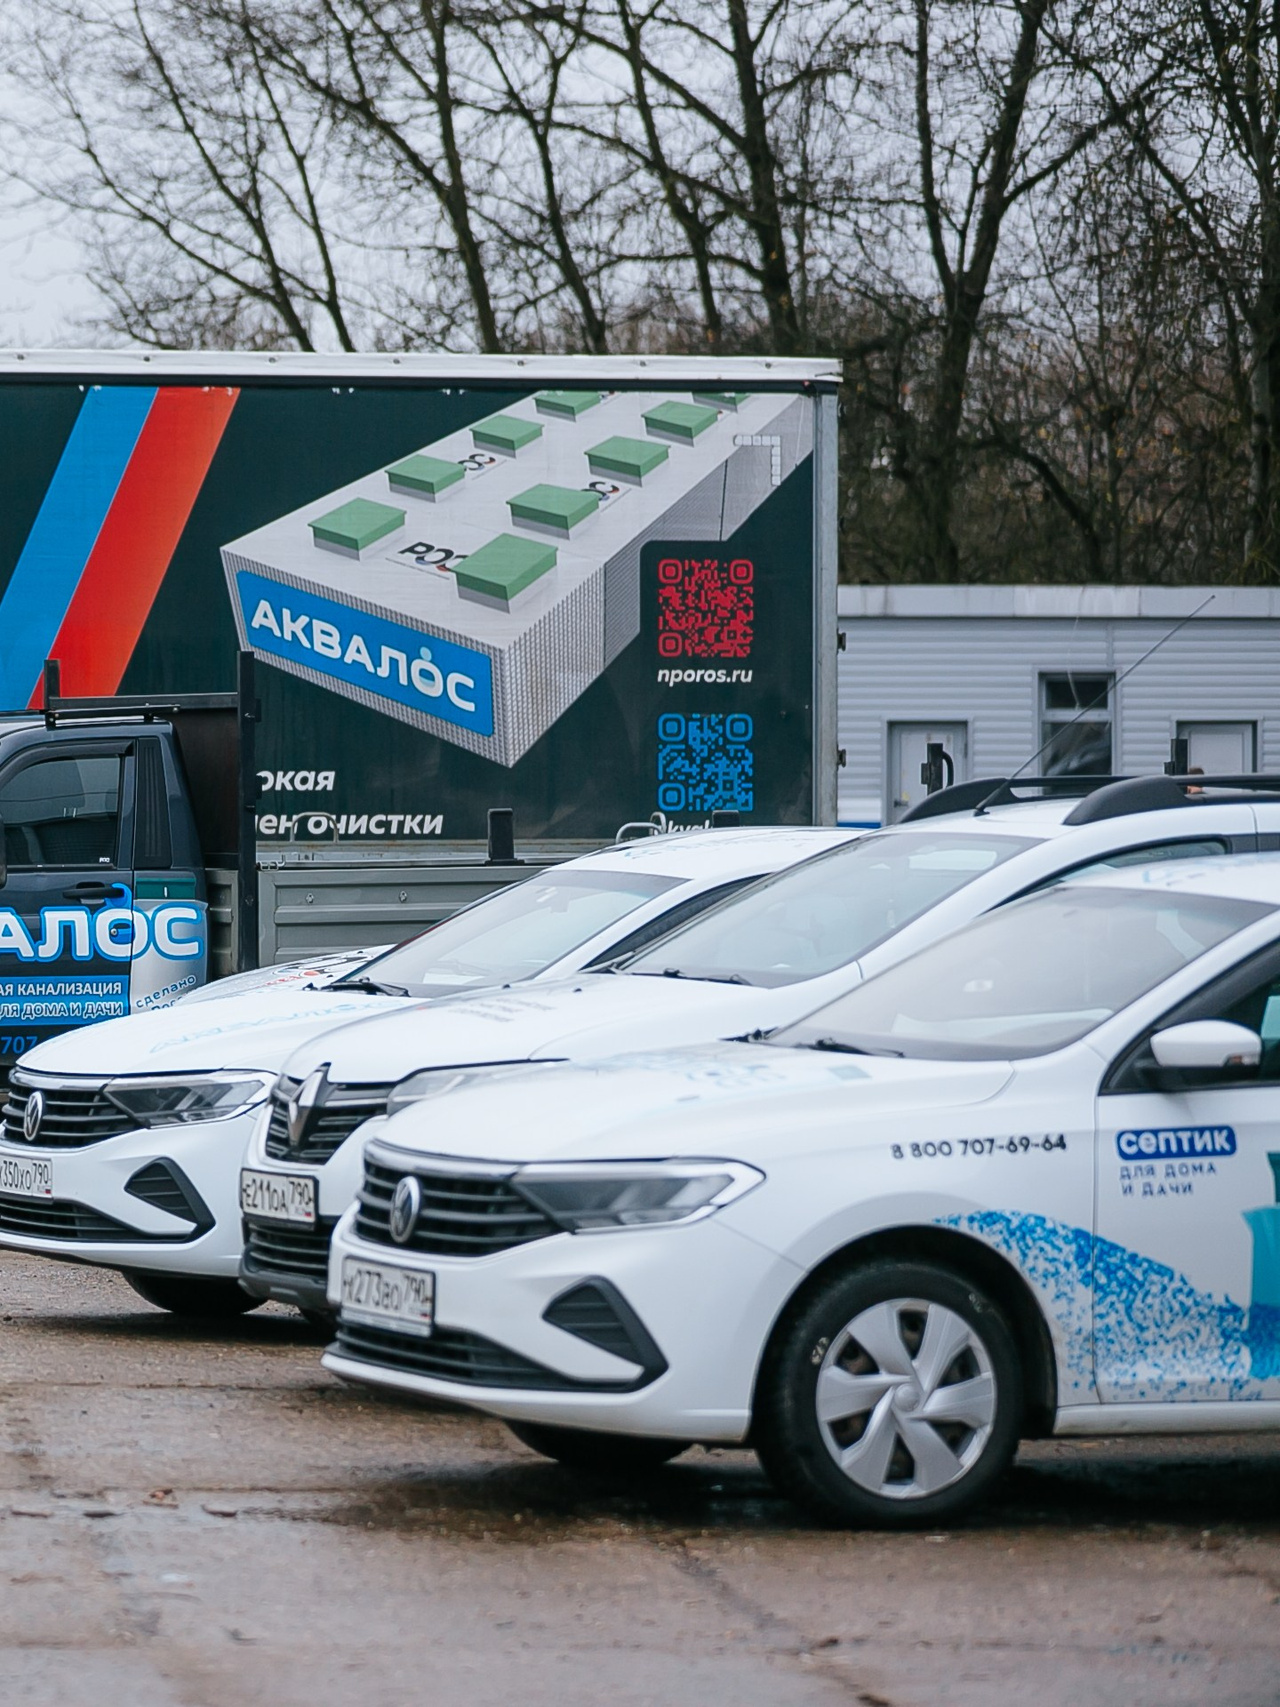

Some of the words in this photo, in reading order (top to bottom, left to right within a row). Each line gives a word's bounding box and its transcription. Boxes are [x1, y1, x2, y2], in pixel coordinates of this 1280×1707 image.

[251, 599, 475, 712] АКВАЛОС
[657, 668, 753, 687] nporos.ru
[255, 814, 298, 835] ен
[307, 814, 444, 835] очистки
[17, 982, 122, 997] КАНАЛИЗАЦИЯ
[136, 975, 197, 1008] сделано
[22, 1002, 68, 1019] ДОМА
[70, 1002, 81, 1017] И
[83, 1000, 124, 1019] ДАЧИ
[891, 1143, 904, 1159] 8
[910, 1141, 952, 1158] 800
[958, 1134, 1067, 1156] 707-69-64
